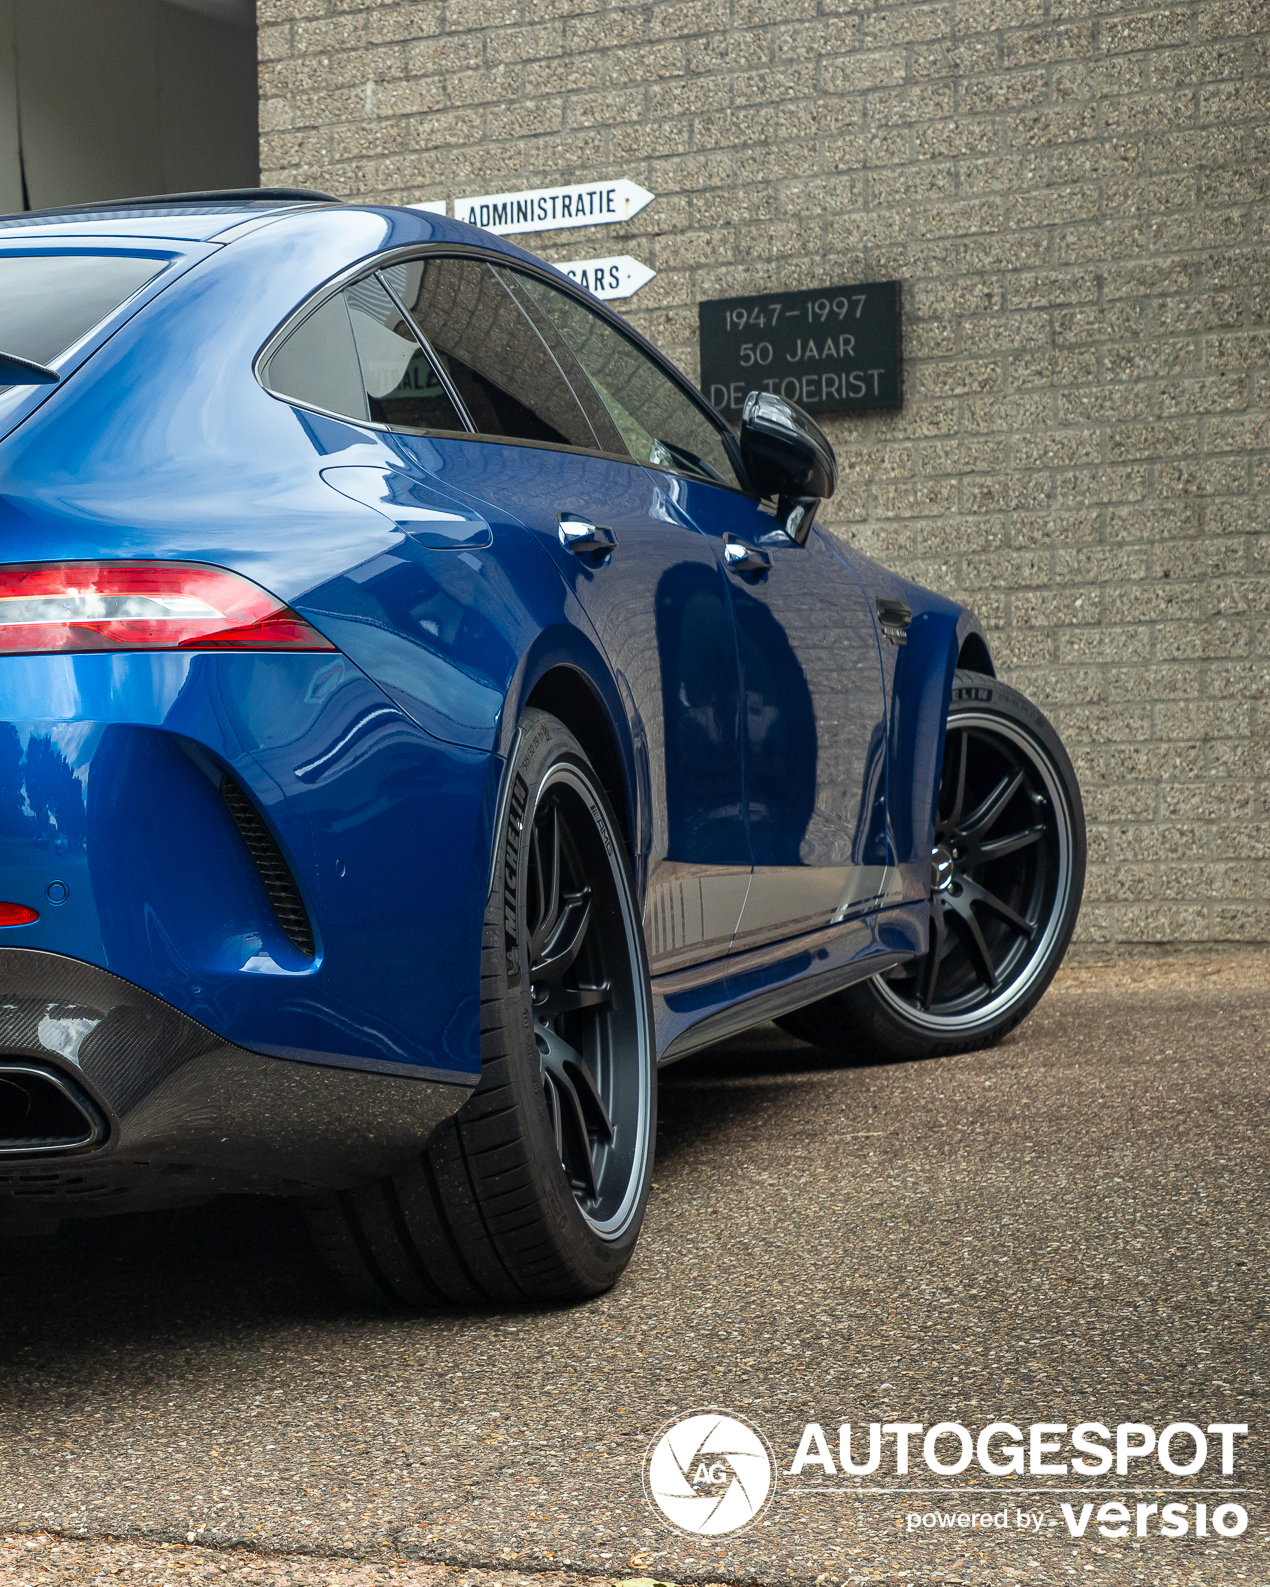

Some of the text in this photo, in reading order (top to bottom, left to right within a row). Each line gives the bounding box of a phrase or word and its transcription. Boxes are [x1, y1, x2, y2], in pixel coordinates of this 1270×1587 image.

[468, 188, 617, 228] ADMINISTRATIE
[739, 333, 856, 367] 50 JAAR
[710, 368, 886, 411] DE TOERIST
[504, 774, 529, 939] MICHELIN
